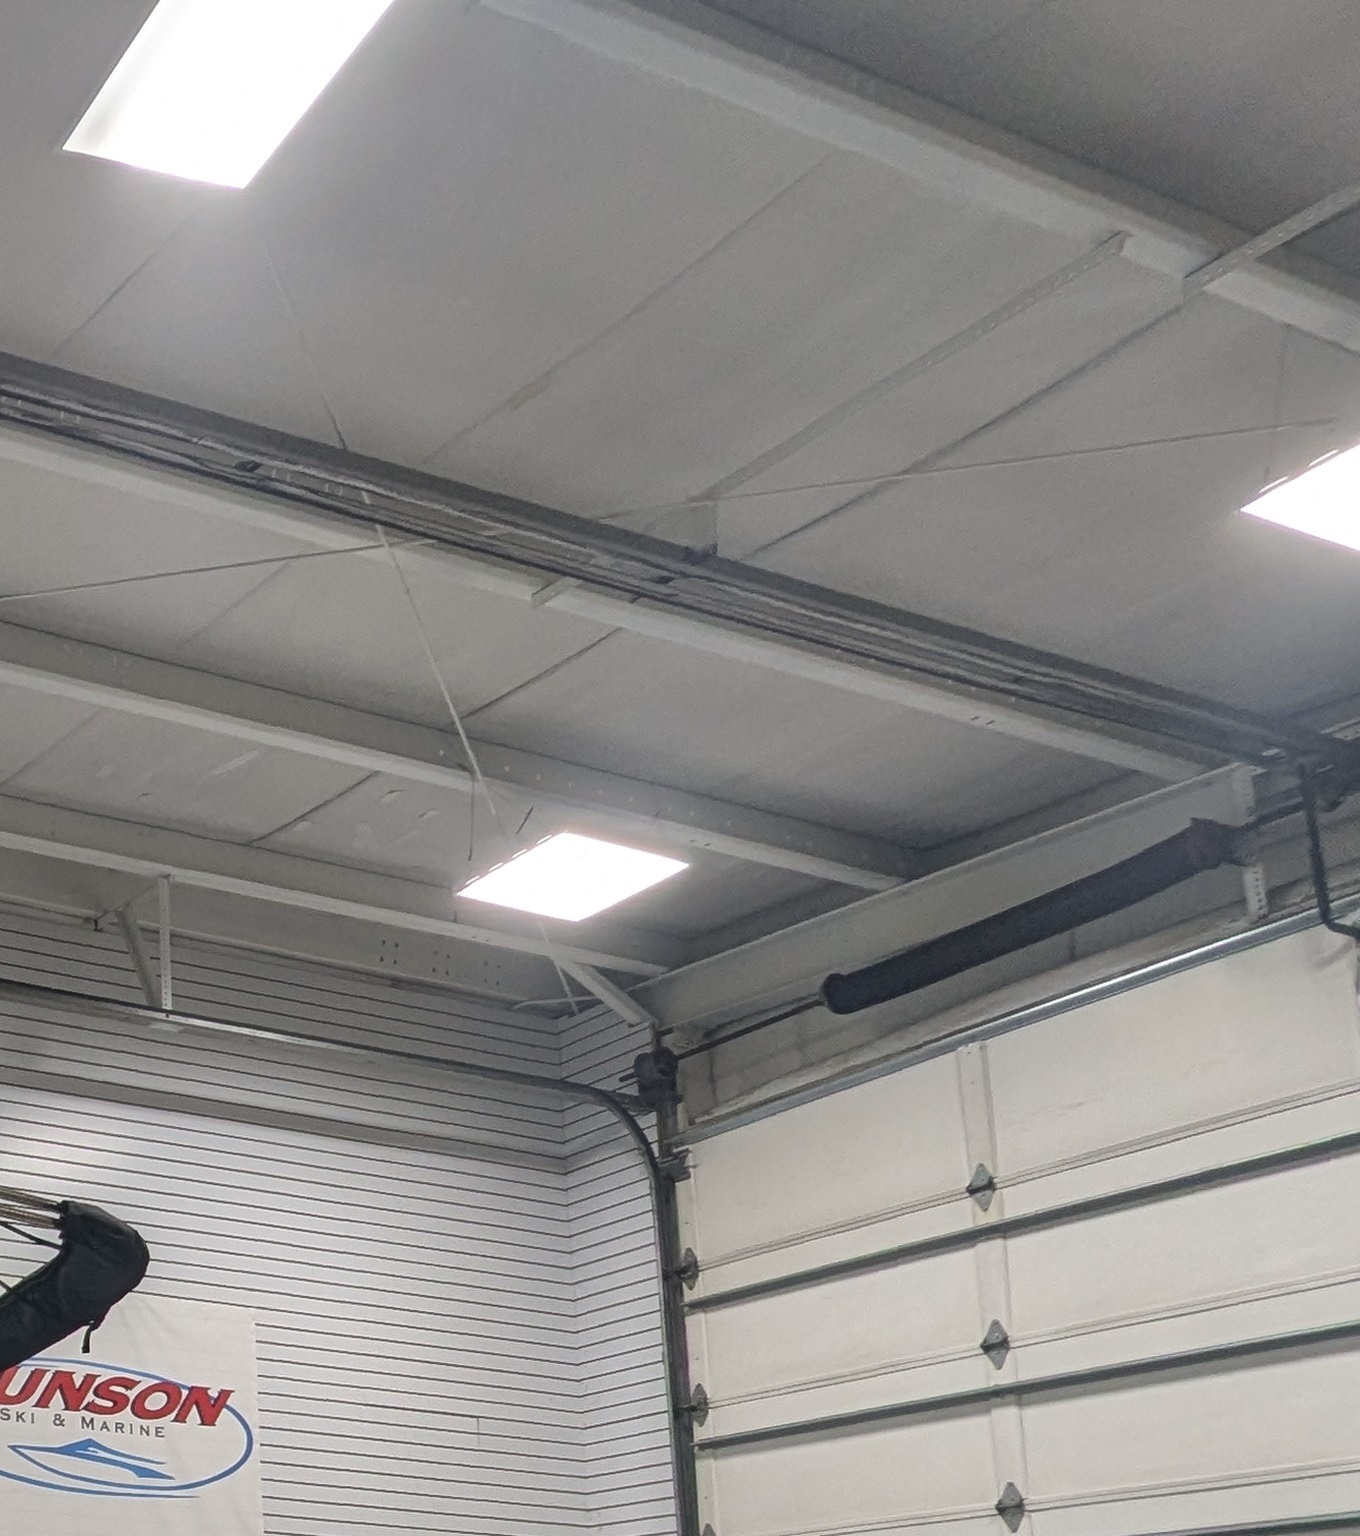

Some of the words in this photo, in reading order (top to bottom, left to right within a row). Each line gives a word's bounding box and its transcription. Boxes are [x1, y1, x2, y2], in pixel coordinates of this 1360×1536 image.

[0, 1407, 35, 1424] SKI
[52, 1413, 66, 1427] &
[80, 1416, 166, 1438] MARINE
